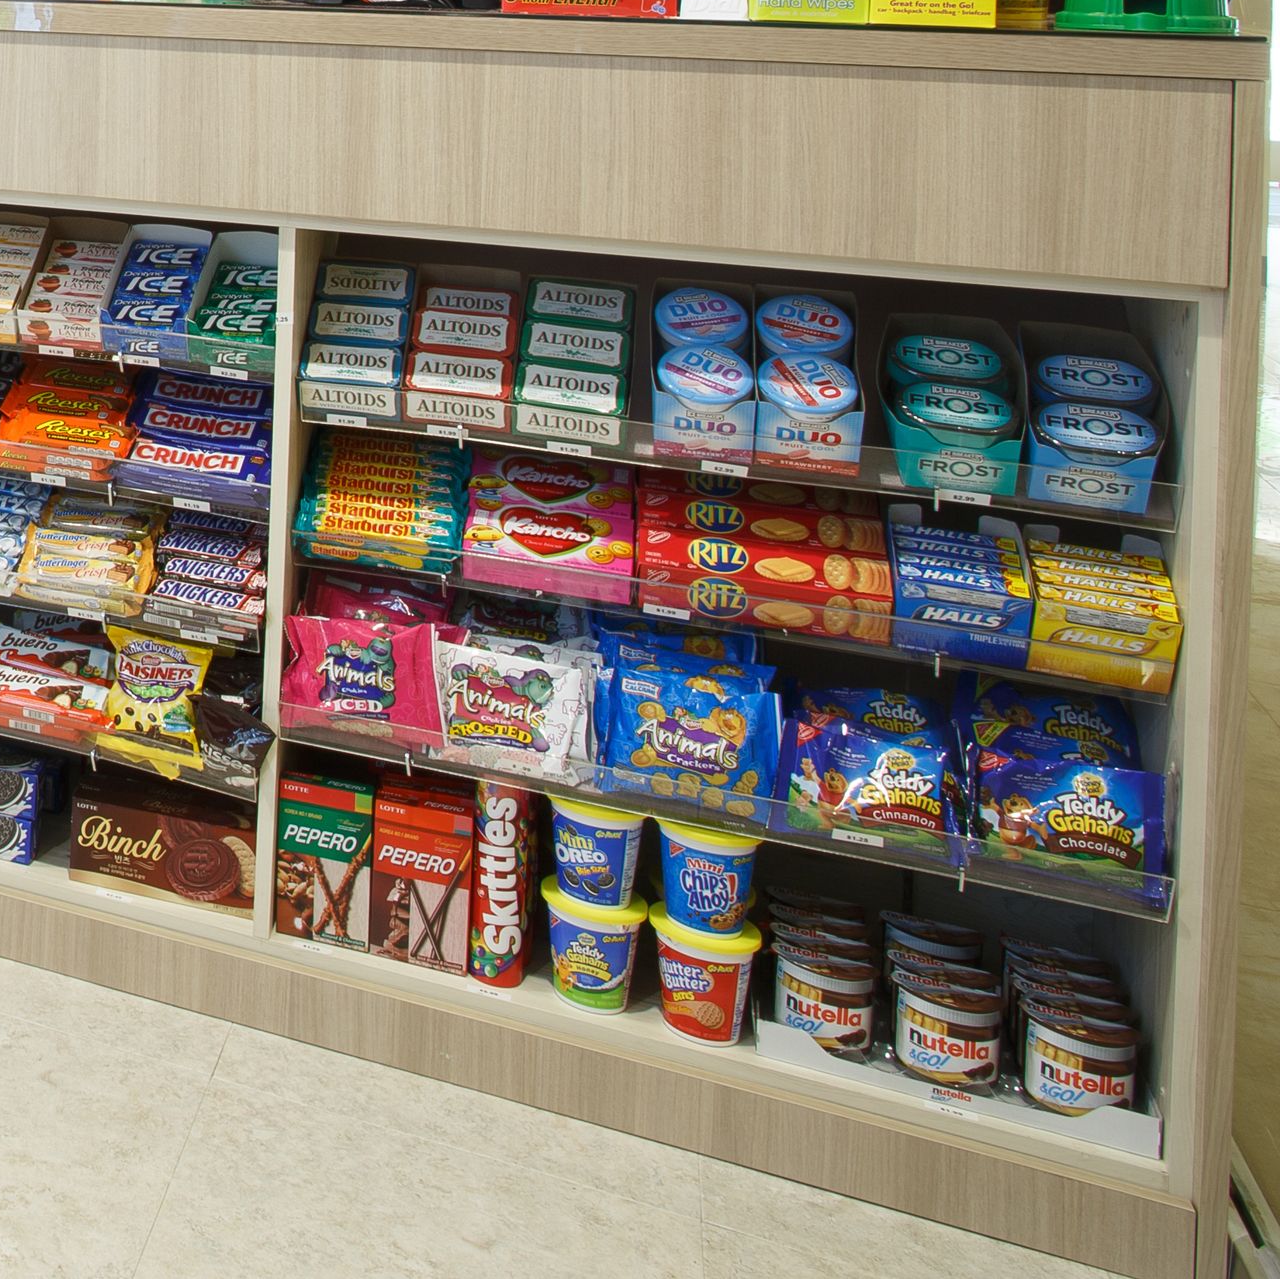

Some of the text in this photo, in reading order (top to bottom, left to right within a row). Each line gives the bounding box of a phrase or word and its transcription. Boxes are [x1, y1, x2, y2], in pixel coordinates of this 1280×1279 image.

[136, 248, 197, 265] ICE
[125, 276, 187, 293] ICE
[668, 299, 729, 317] DUO
[534, 331, 616, 353] ALTOIDS
[314, 351, 388, 369] ALTOIDS
[901, 346, 993, 367] FROST
[419, 361, 496, 382] ALTOIDS
[909, 392, 1005, 416] FROST
[36, 420, 113, 440] Reese's
[147, 410, 254, 438] CRUNCH
[775, 426, 843, 446] DUO
[134, 444, 239, 471] CRUNCH
[503, 517, 591, 543] Kancho
[690, 541, 746, 571] RITZ
[167, 558, 248, 582] SNICKERS
[157, 580, 243, 608] SNICKERS
[921, 607, 1005, 629] HALLS
[2, 633, 58, 651] bueno
[1061, 630, 1146, 653] HALLS
[318, 657, 395, 693] Animals
[331, 697, 383, 713] ICED
[636, 720, 738, 769] Animals
[666, 753, 721, 772] Crackers
[284, 783, 310, 795] LOTTE
[380, 803, 406, 815] LOTTE
[872, 808, 937, 829] Cinnamon
[1058, 794, 1125, 823] Teddy
[1047, 809, 1134, 842] Grahams
[79, 815, 167, 862] Binch
[284, 823, 357, 853] PEPERO
[1058, 836, 1127, 859] Chocolate
[378, 845, 455, 876] PEPERO
[555, 847, 607, 864] OREO
[686, 857, 725, 872] Mini
[480, 796, 521, 956] Skittles
[786, 994, 862, 1027] nutella
[909, 1025, 989, 1061] nutella
[1040, 1060, 1125, 1096] nutella
